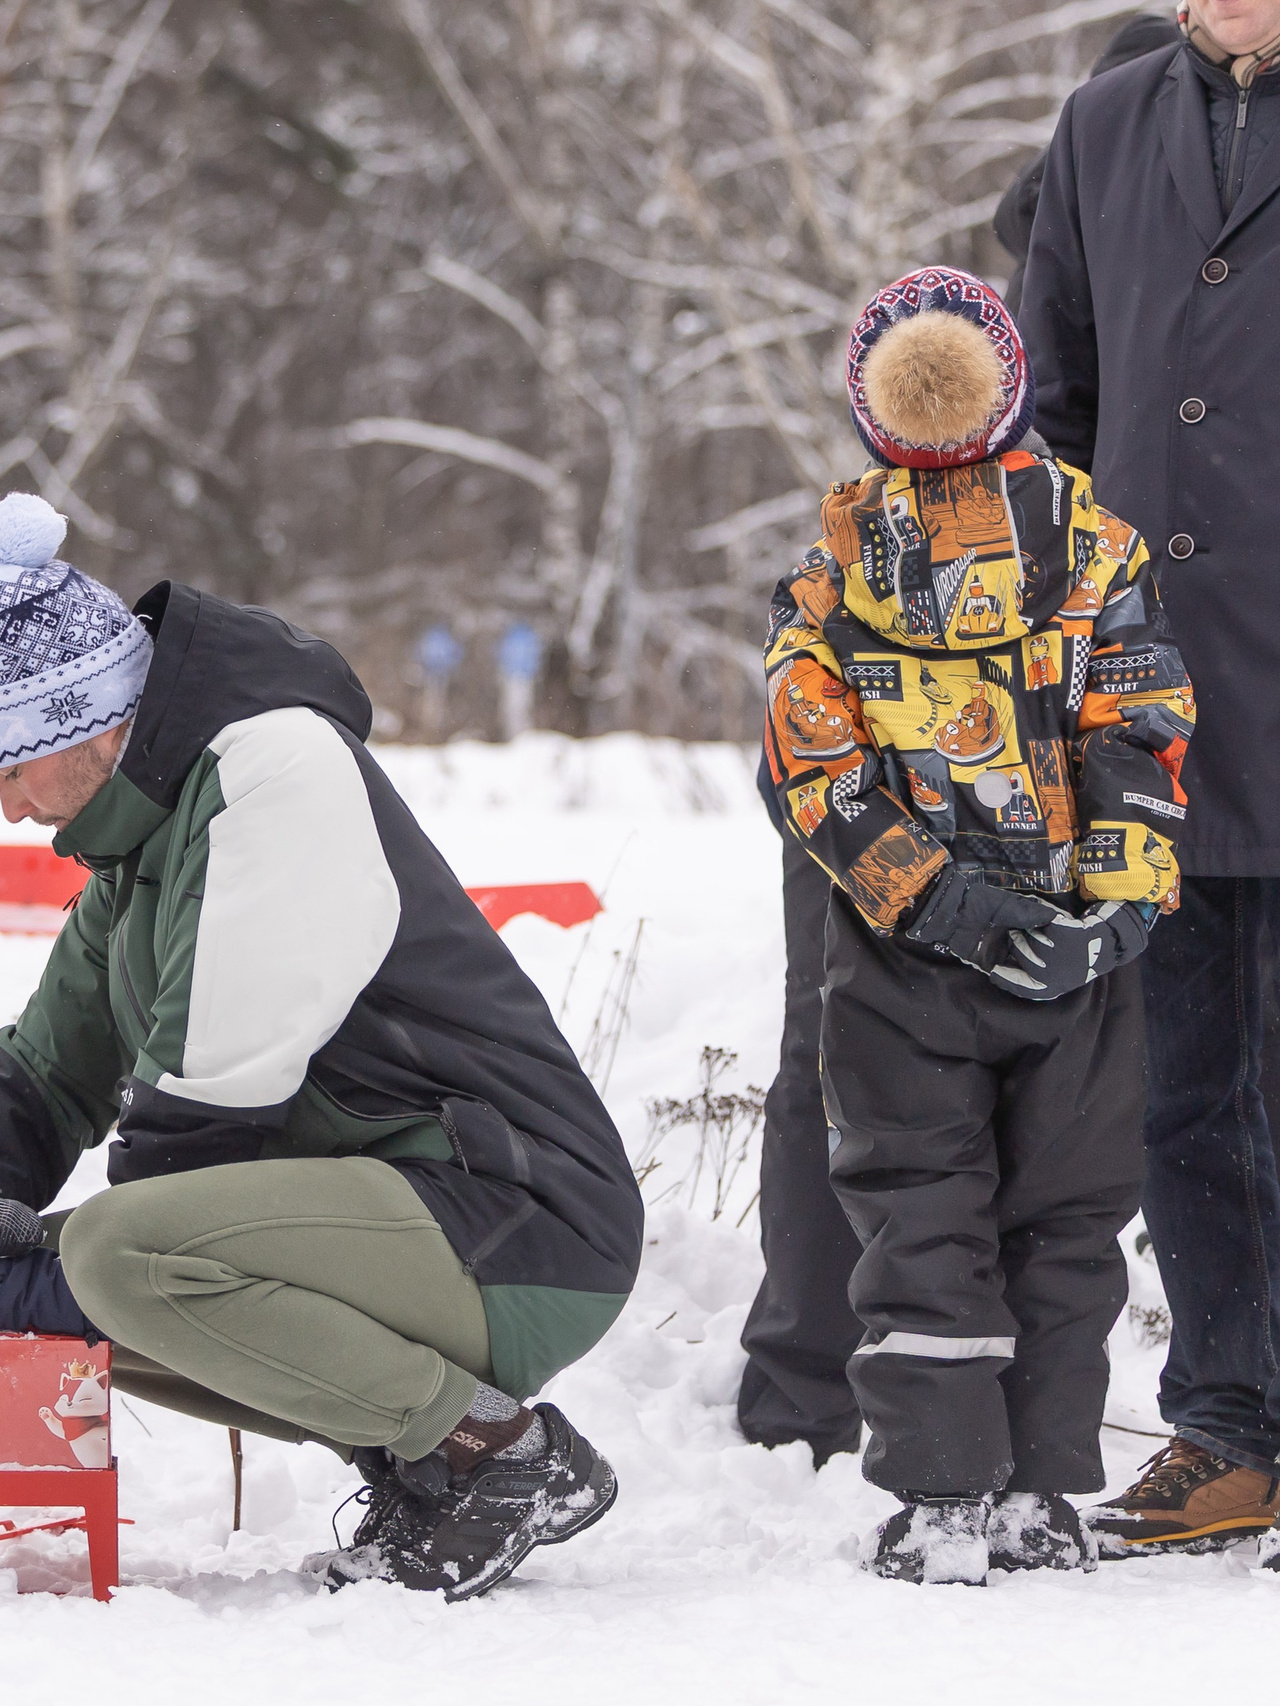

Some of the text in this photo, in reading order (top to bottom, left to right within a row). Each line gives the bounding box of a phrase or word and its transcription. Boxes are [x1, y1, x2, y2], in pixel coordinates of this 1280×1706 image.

[863, 544, 874, 581] FINISH
[1102, 681, 1139, 693] START
[1124, 794, 1155, 807] BUMPER
[1155, 801, 1170, 812] CAR
[1002, 822, 1038, 830] WINNER
[508, 1481, 545, 1491] TERREX
